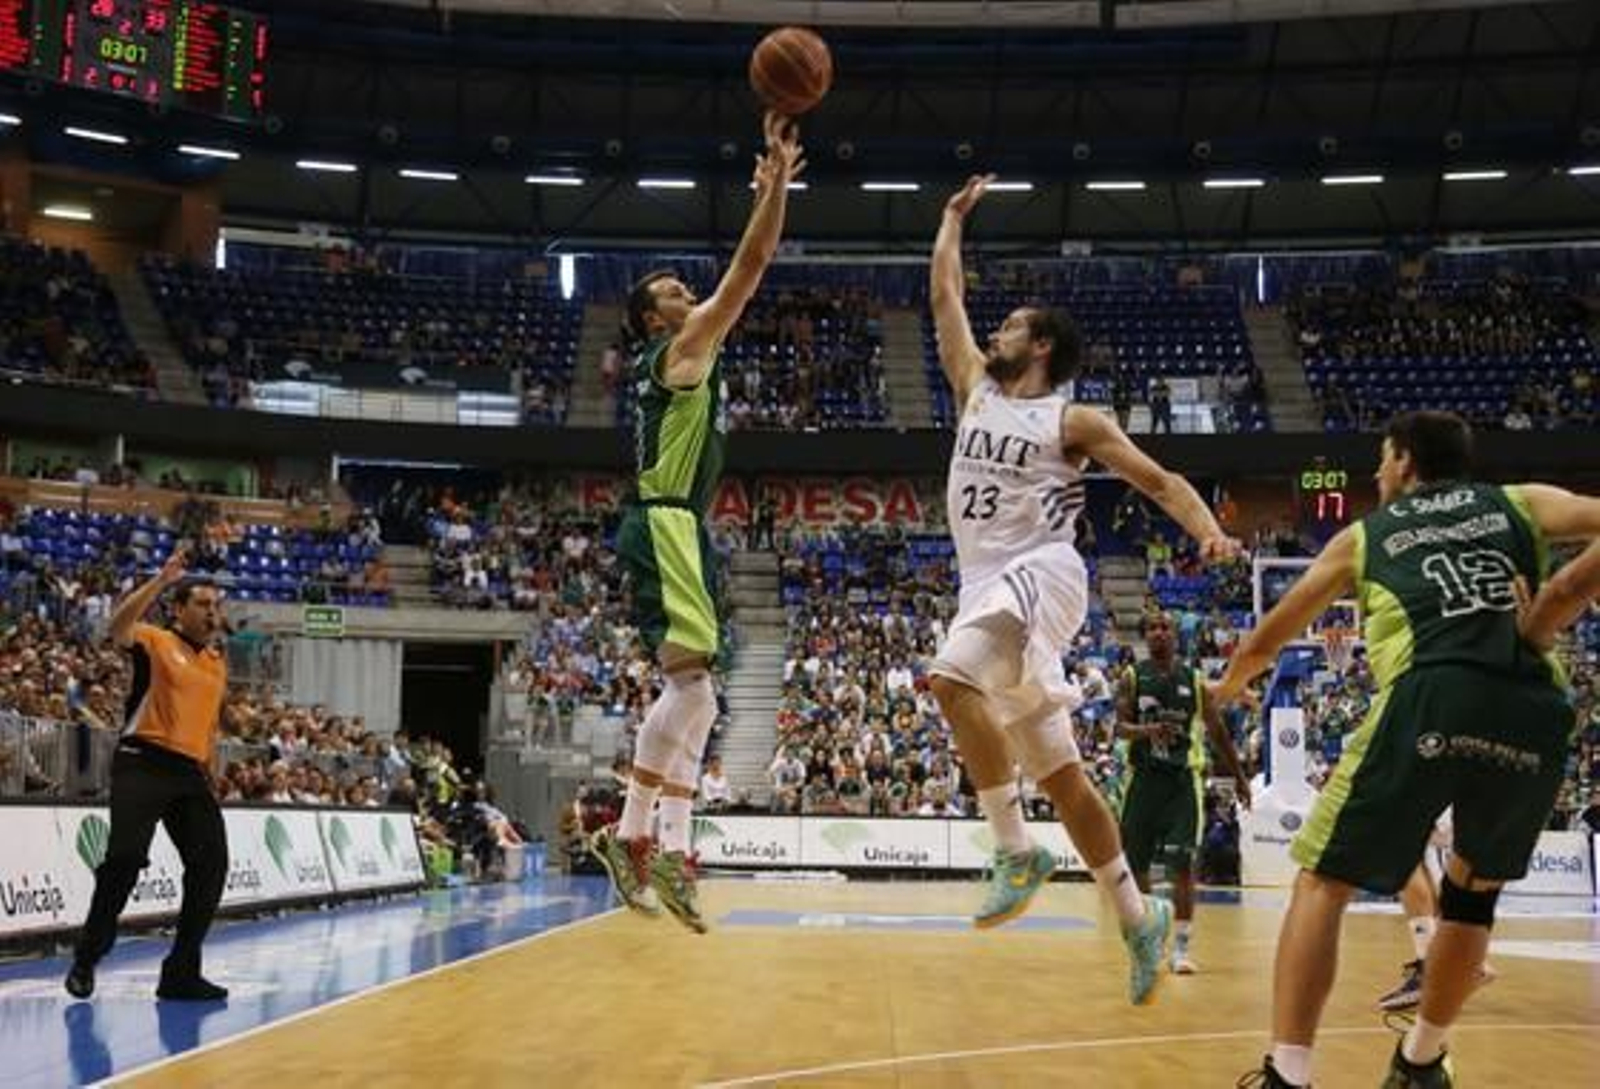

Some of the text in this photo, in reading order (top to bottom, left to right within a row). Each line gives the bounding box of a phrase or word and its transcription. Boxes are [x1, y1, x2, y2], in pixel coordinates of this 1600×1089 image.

[961, 484, 1000, 520] 23
[1318, 493, 1343, 519] 17
[1421, 549, 1517, 617] 12
[720, 841, 787, 860] Unicaja
[863, 845, 929, 865] Unicaja
[0, 874, 65, 920] Unicaja
